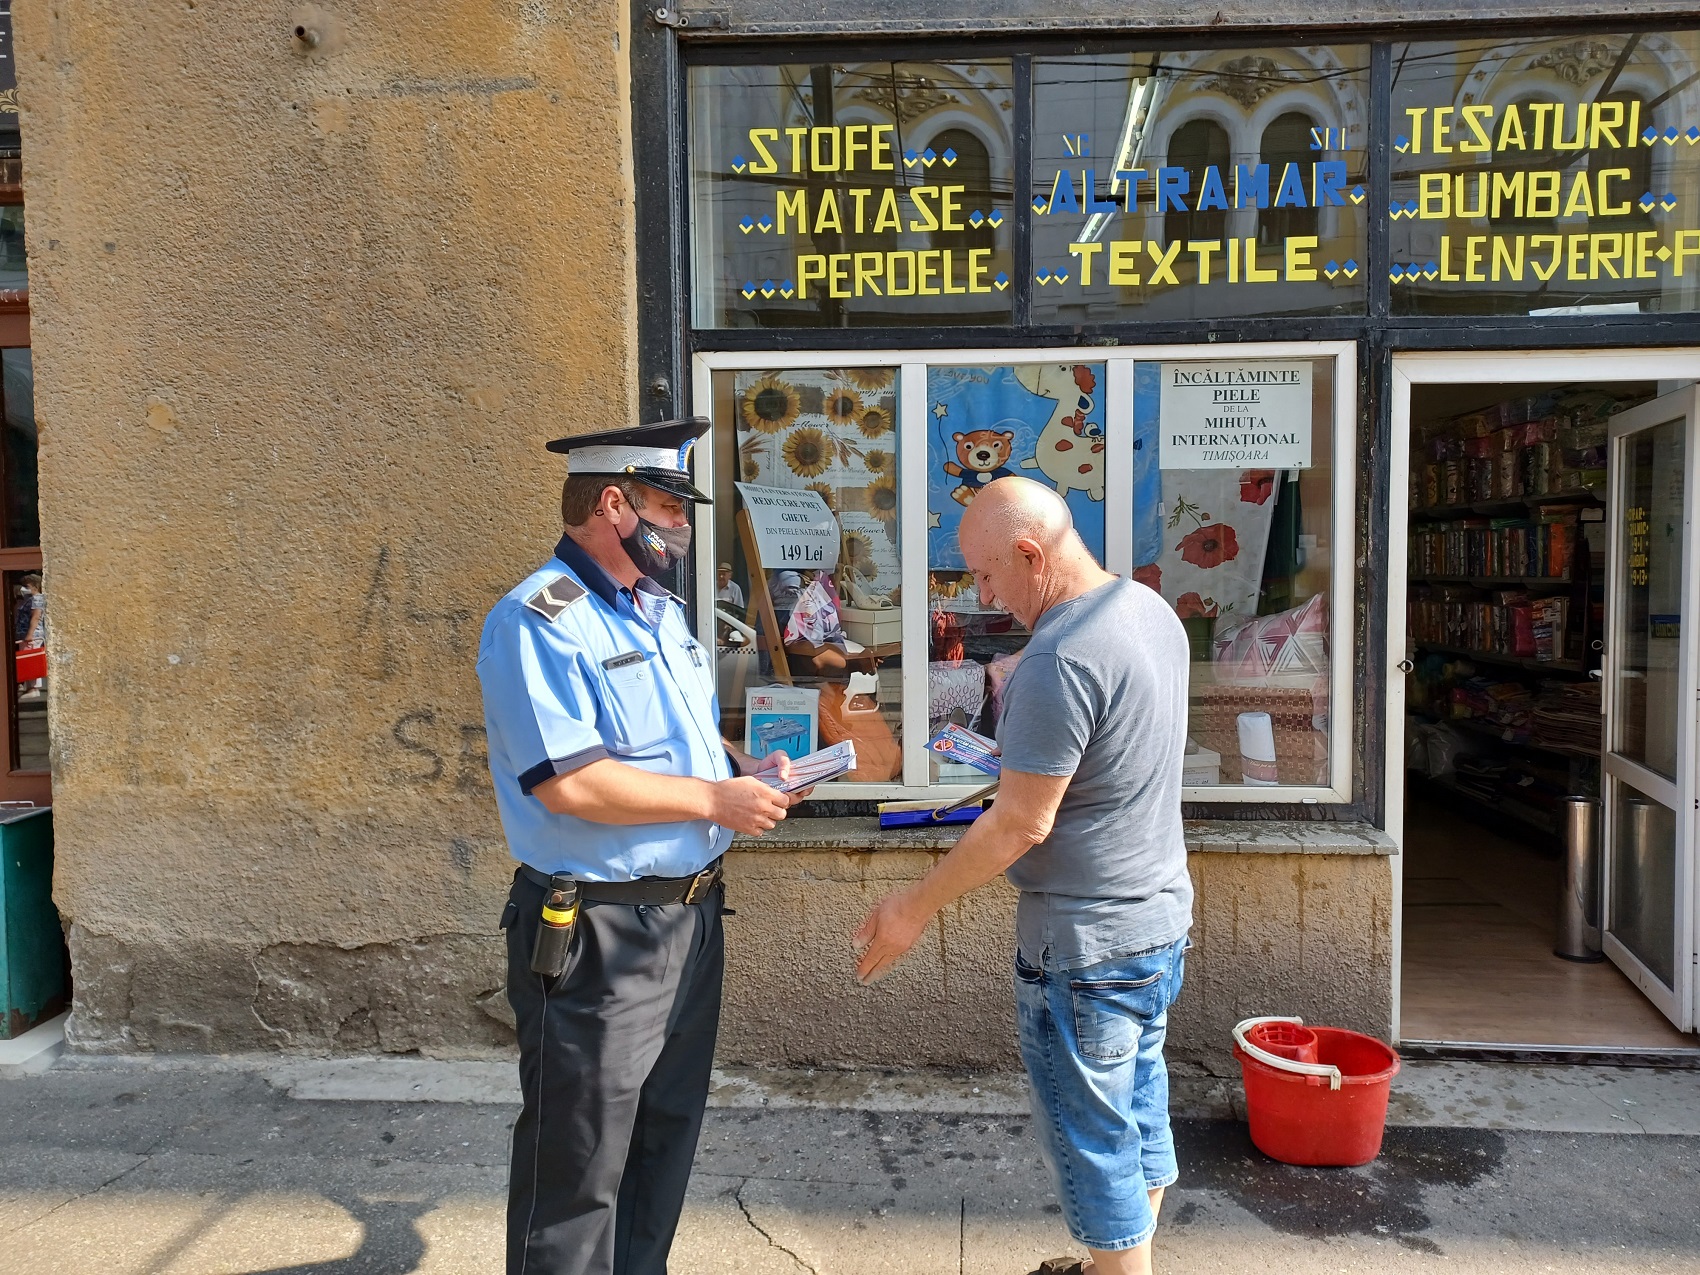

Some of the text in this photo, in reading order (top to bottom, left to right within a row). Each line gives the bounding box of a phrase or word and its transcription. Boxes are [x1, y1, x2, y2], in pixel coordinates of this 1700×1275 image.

[1309, 127, 1351, 150] SRL
[1405, 101, 1641, 154] TESATURI
[748, 124, 894, 173] STOFE
[1062, 133, 1090, 157] SC
[1046, 160, 1347, 215] ALTRAMAR
[1419, 167, 1632, 219] BUMBAC
[776, 185, 965, 235] MATASE
[1068, 235, 1319, 286] TEXTILE
[1440, 231, 1658, 282] LENJERIE
[797, 248, 992, 299] PERDELE
[1213, 389, 1261, 402] PIELE
[1223, 405, 1249, 413] DE LA
[1202, 450, 1269, 463] TIMIȘOARA
[751, 496, 801, 508] REDUCERE
[781, 512, 810, 523] GHETE
[765, 527, 778, 535] DIN
[780, 544, 823, 562] 149 Lei
